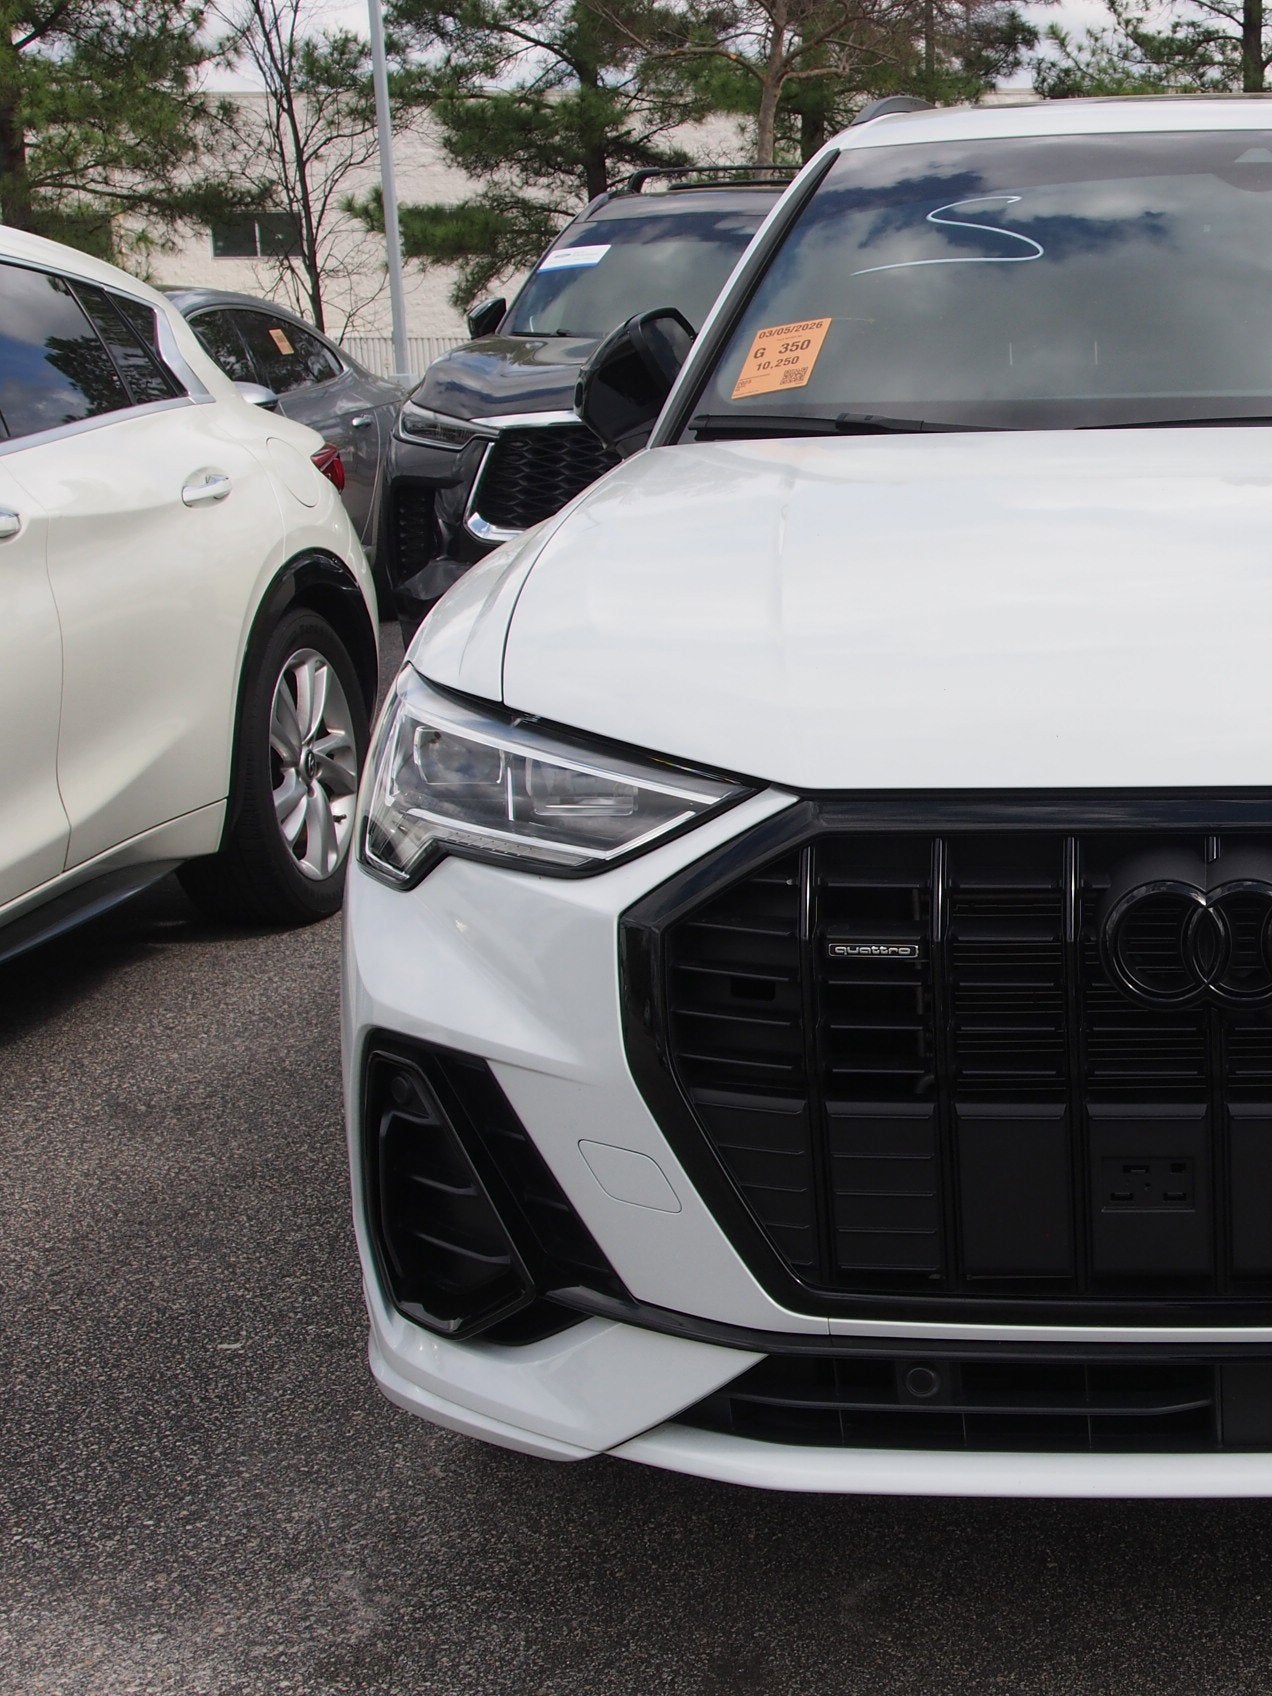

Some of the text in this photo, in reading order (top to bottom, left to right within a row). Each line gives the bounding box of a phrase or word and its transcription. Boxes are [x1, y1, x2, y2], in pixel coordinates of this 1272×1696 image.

[758, 321, 823, 340] 03/05/2026
[753, 339, 812, 359] G 350
[834, 945, 911, 956] quattro
